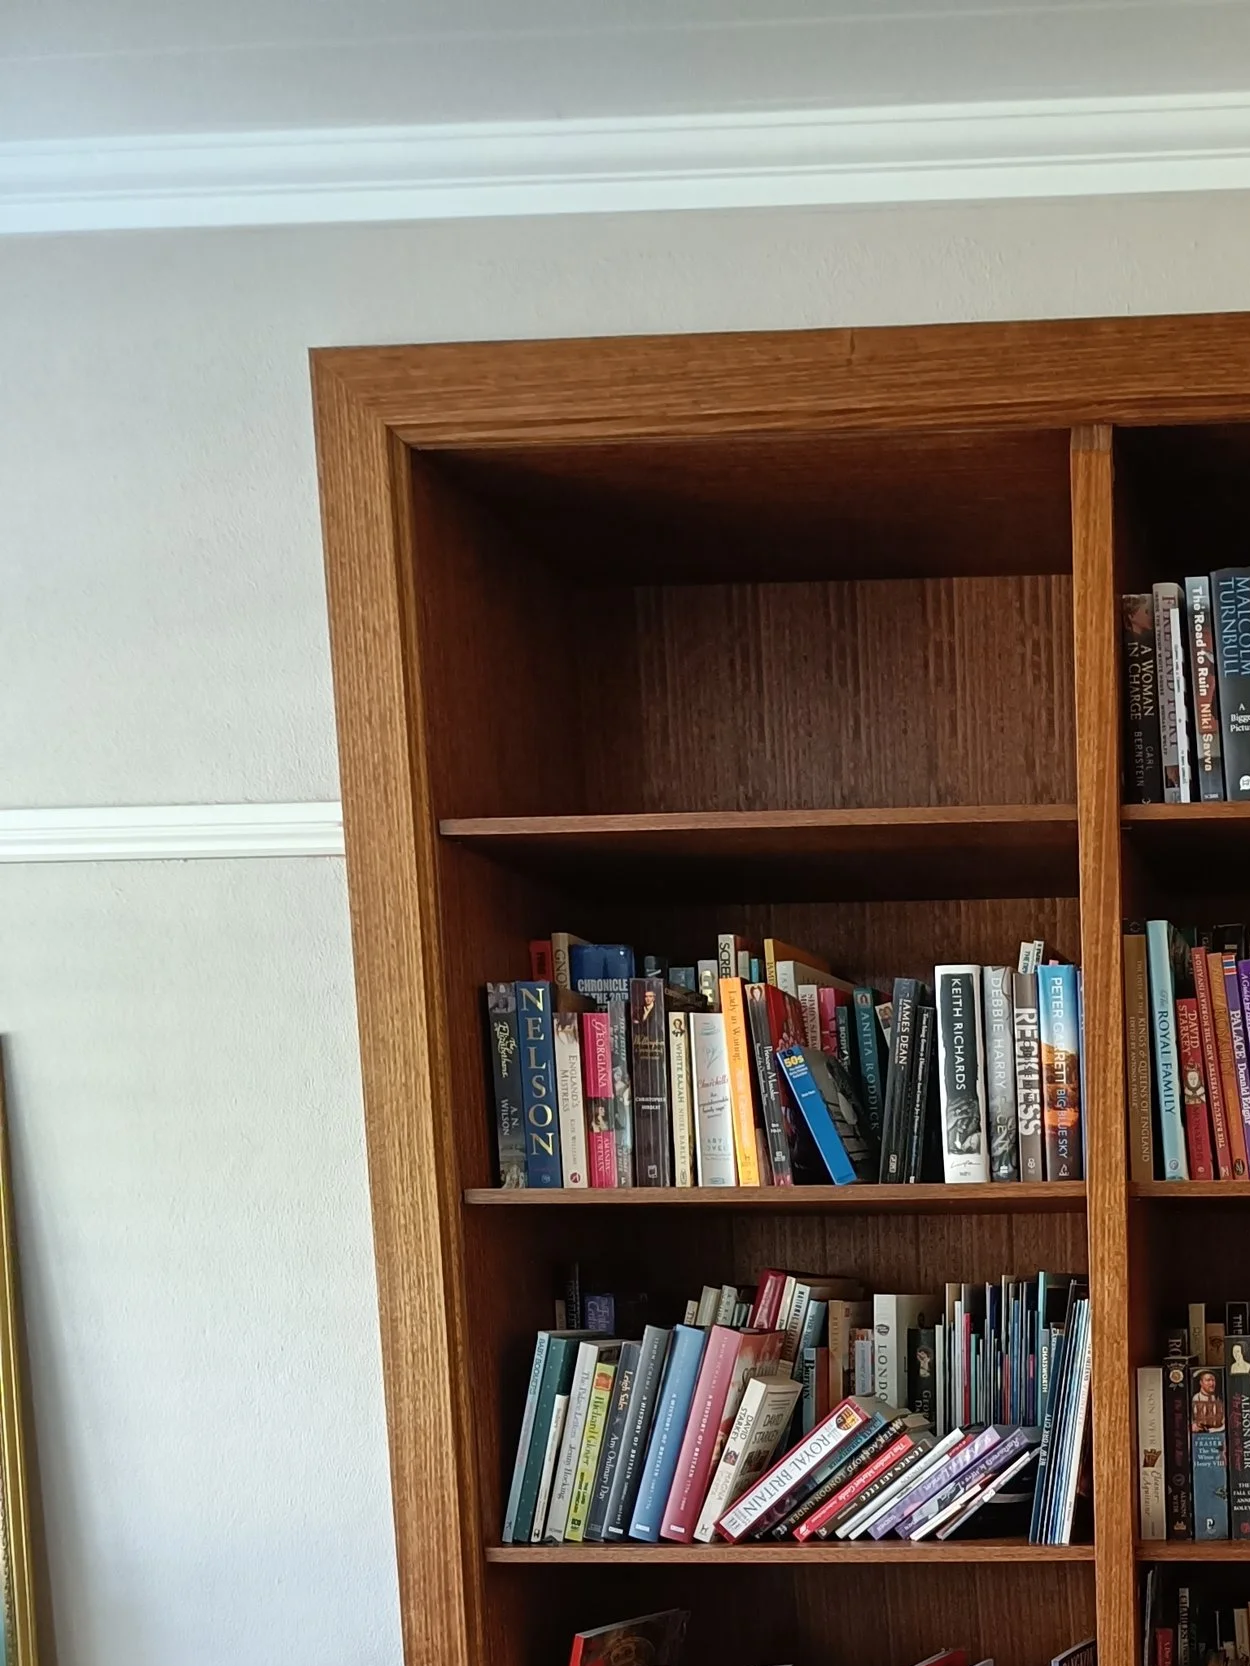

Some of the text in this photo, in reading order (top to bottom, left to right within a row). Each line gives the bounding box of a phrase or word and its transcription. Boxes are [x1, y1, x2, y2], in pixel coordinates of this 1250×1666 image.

[1192, 586, 1208, 696] The Road to Ruin
[1219, 580, 1237, 679] TURNBULL
[1125, 641, 1144, 721] IN CHARGE
[1139, 644, 1157, 716] A WOMAN
[1131, 731, 1146, 786] BERNSTEIN
[1144, 745, 1154, 770] CARL
[1200, 703, 1214, 771] Niki Savva
[578, 978, 629, 992] CHRONICLE
[591, 1019, 609, 1087] GEORGIANA
[898, 998, 911, 1064] JAMES DEAN
[950, 978, 967, 1091] KEITH RICHARDS
[991, 977, 1006, 1088] DEBBIE HARRY
[1157, 1010, 1170, 1056] ROYAL
[1177, 1004, 1190, 1055] STARKEY
[1187, 1011, 1199, 1048] DAVID
[1229, 1009, 1245, 1059] PALACE
[1237, 1062, 1250, 1096] Donald
[520, 987, 555, 1156] NELSON
[560, 1069, 570, 1112] MISTRESS
[568, 1054, 580, 1108] ENGLAND'S
[860, 1012, 878, 1129] ANITA RODDICK
[1014, 1007, 1040, 1135] RECKLESS
[1050, 977, 1068, 1158] PETER GARRETT BIG BLUE SKY
[1161, 1062, 1175, 1115] FAMILY
[500, 1099, 511, 1135] WILSON
[617, 1369, 632, 1411] Leigh Sales
[563, 1443, 576, 1467] Jenny
[729, 1406, 747, 1442] STARKEY
[739, 1414, 753, 1440] DAVID
[1241, 1394, 1250, 1468] ALISON WEIR
[557, 1468, 571, 1501] Hocking
[597, 1432, 618, 1500] Any Ordinary Day
[741, 1432, 830, 1518] ROYAL BRITAIN
[858, 1445, 922, 1502] LONDON ART DECO
